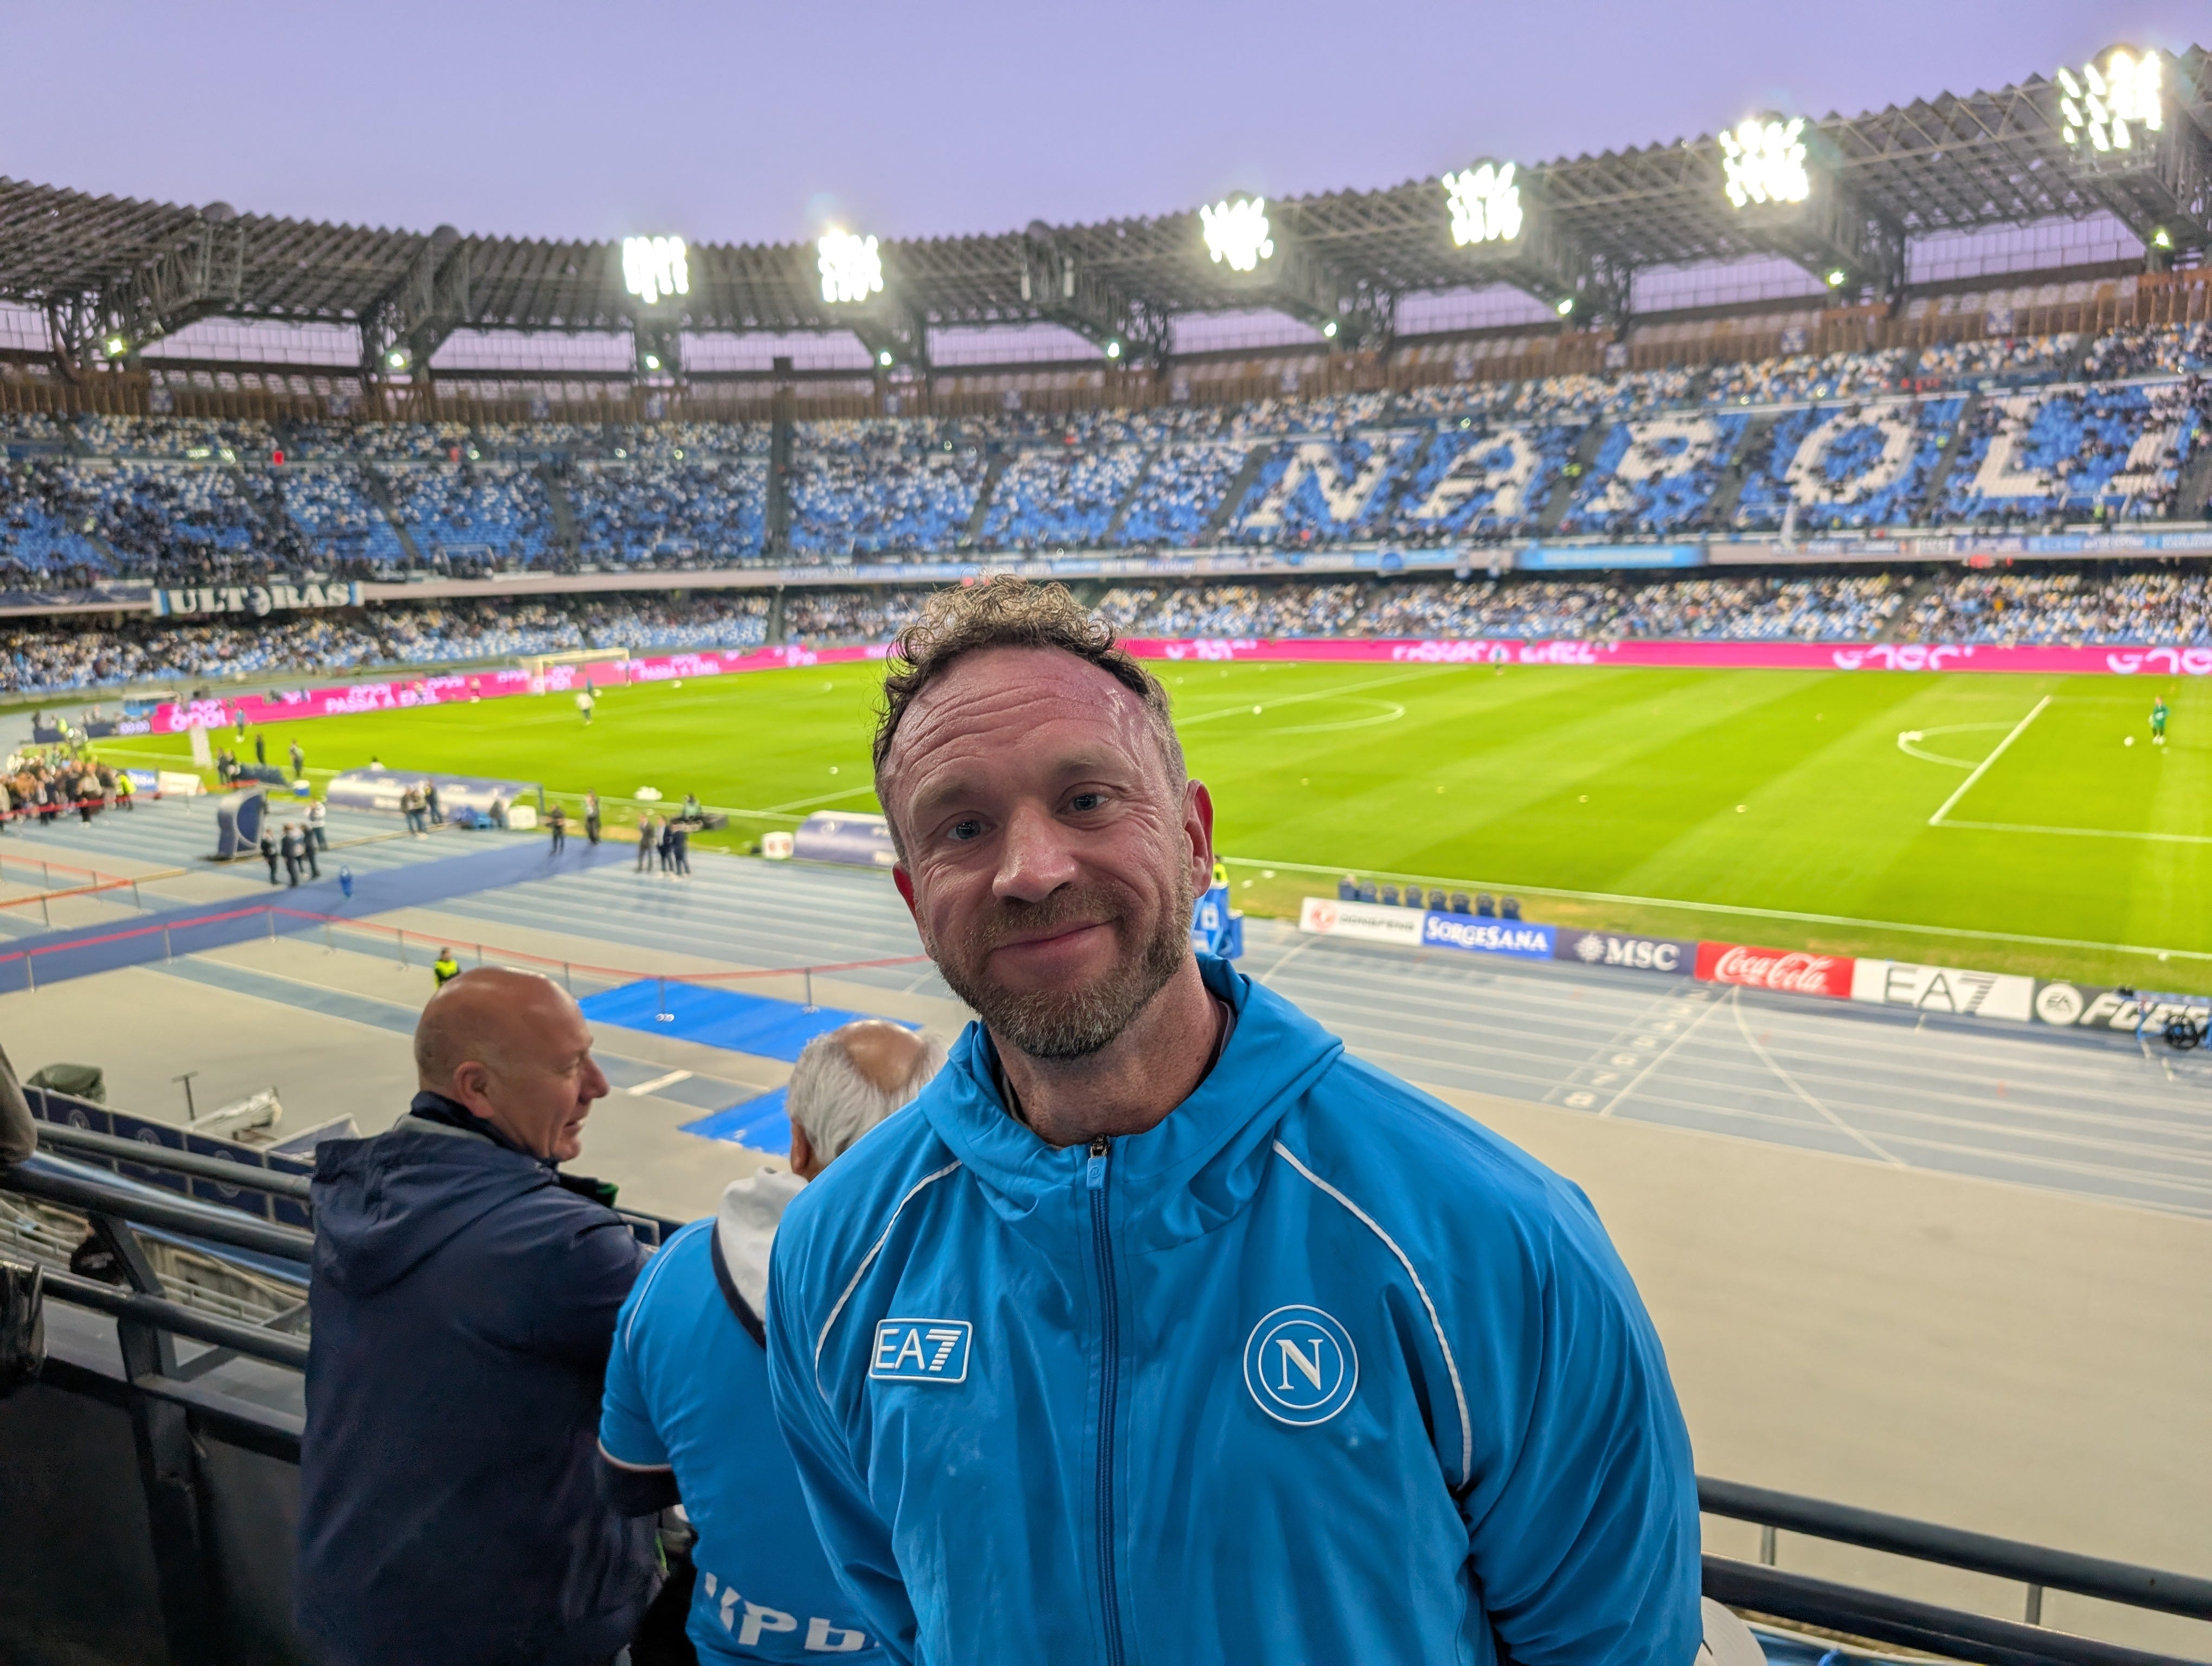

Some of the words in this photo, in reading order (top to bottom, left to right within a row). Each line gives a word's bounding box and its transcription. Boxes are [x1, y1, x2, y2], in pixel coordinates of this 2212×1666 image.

[1240, 386, 2186, 528] NAPOLI
[1604, 937, 1680, 971] MSC
[1884, 966, 1998, 1015] EA7
[874, 1328, 963, 1373] EA7
[1275, 1338, 1322, 1391] N
